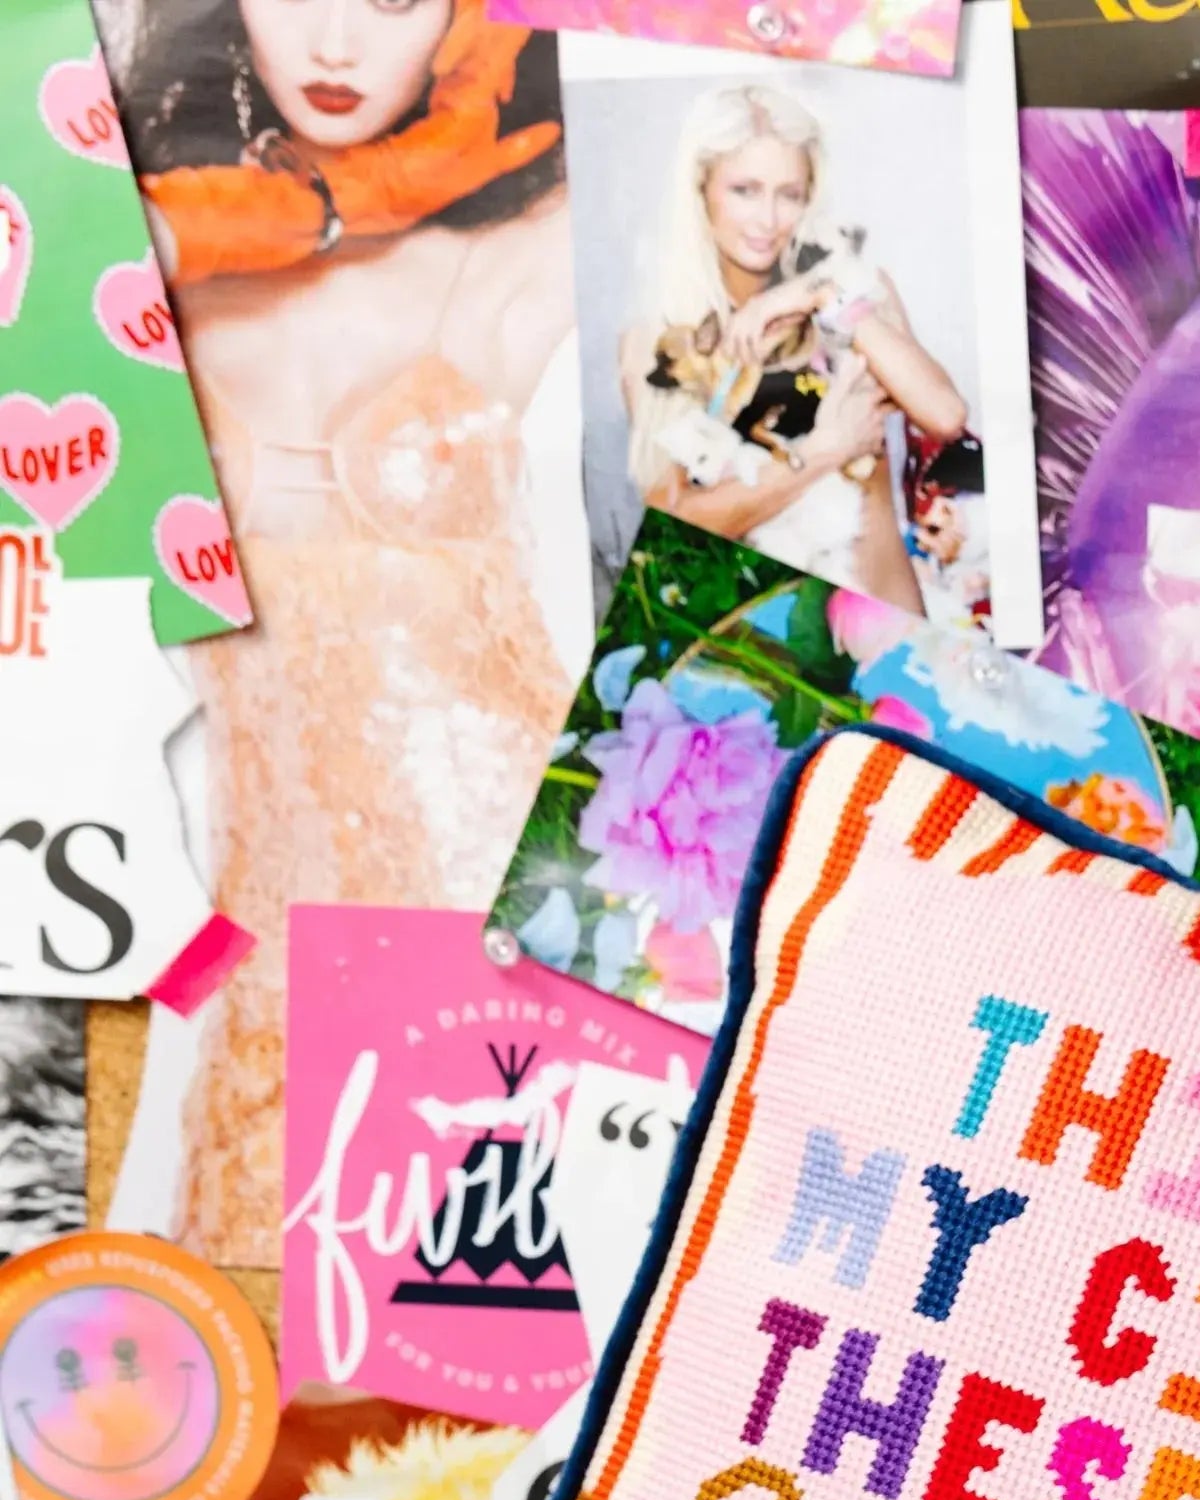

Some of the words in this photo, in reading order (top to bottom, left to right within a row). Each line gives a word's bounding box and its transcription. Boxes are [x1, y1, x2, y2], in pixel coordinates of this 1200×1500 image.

[2, 425, 109, 485] LOVER
[404, 1023, 425, 1048] A
[437, 998, 567, 1031] DARING
[579, 1018, 637, 1066] MIX
[770, 1126, 1030, 1322] MY
[441, 1363, 494, 1392] YOU
